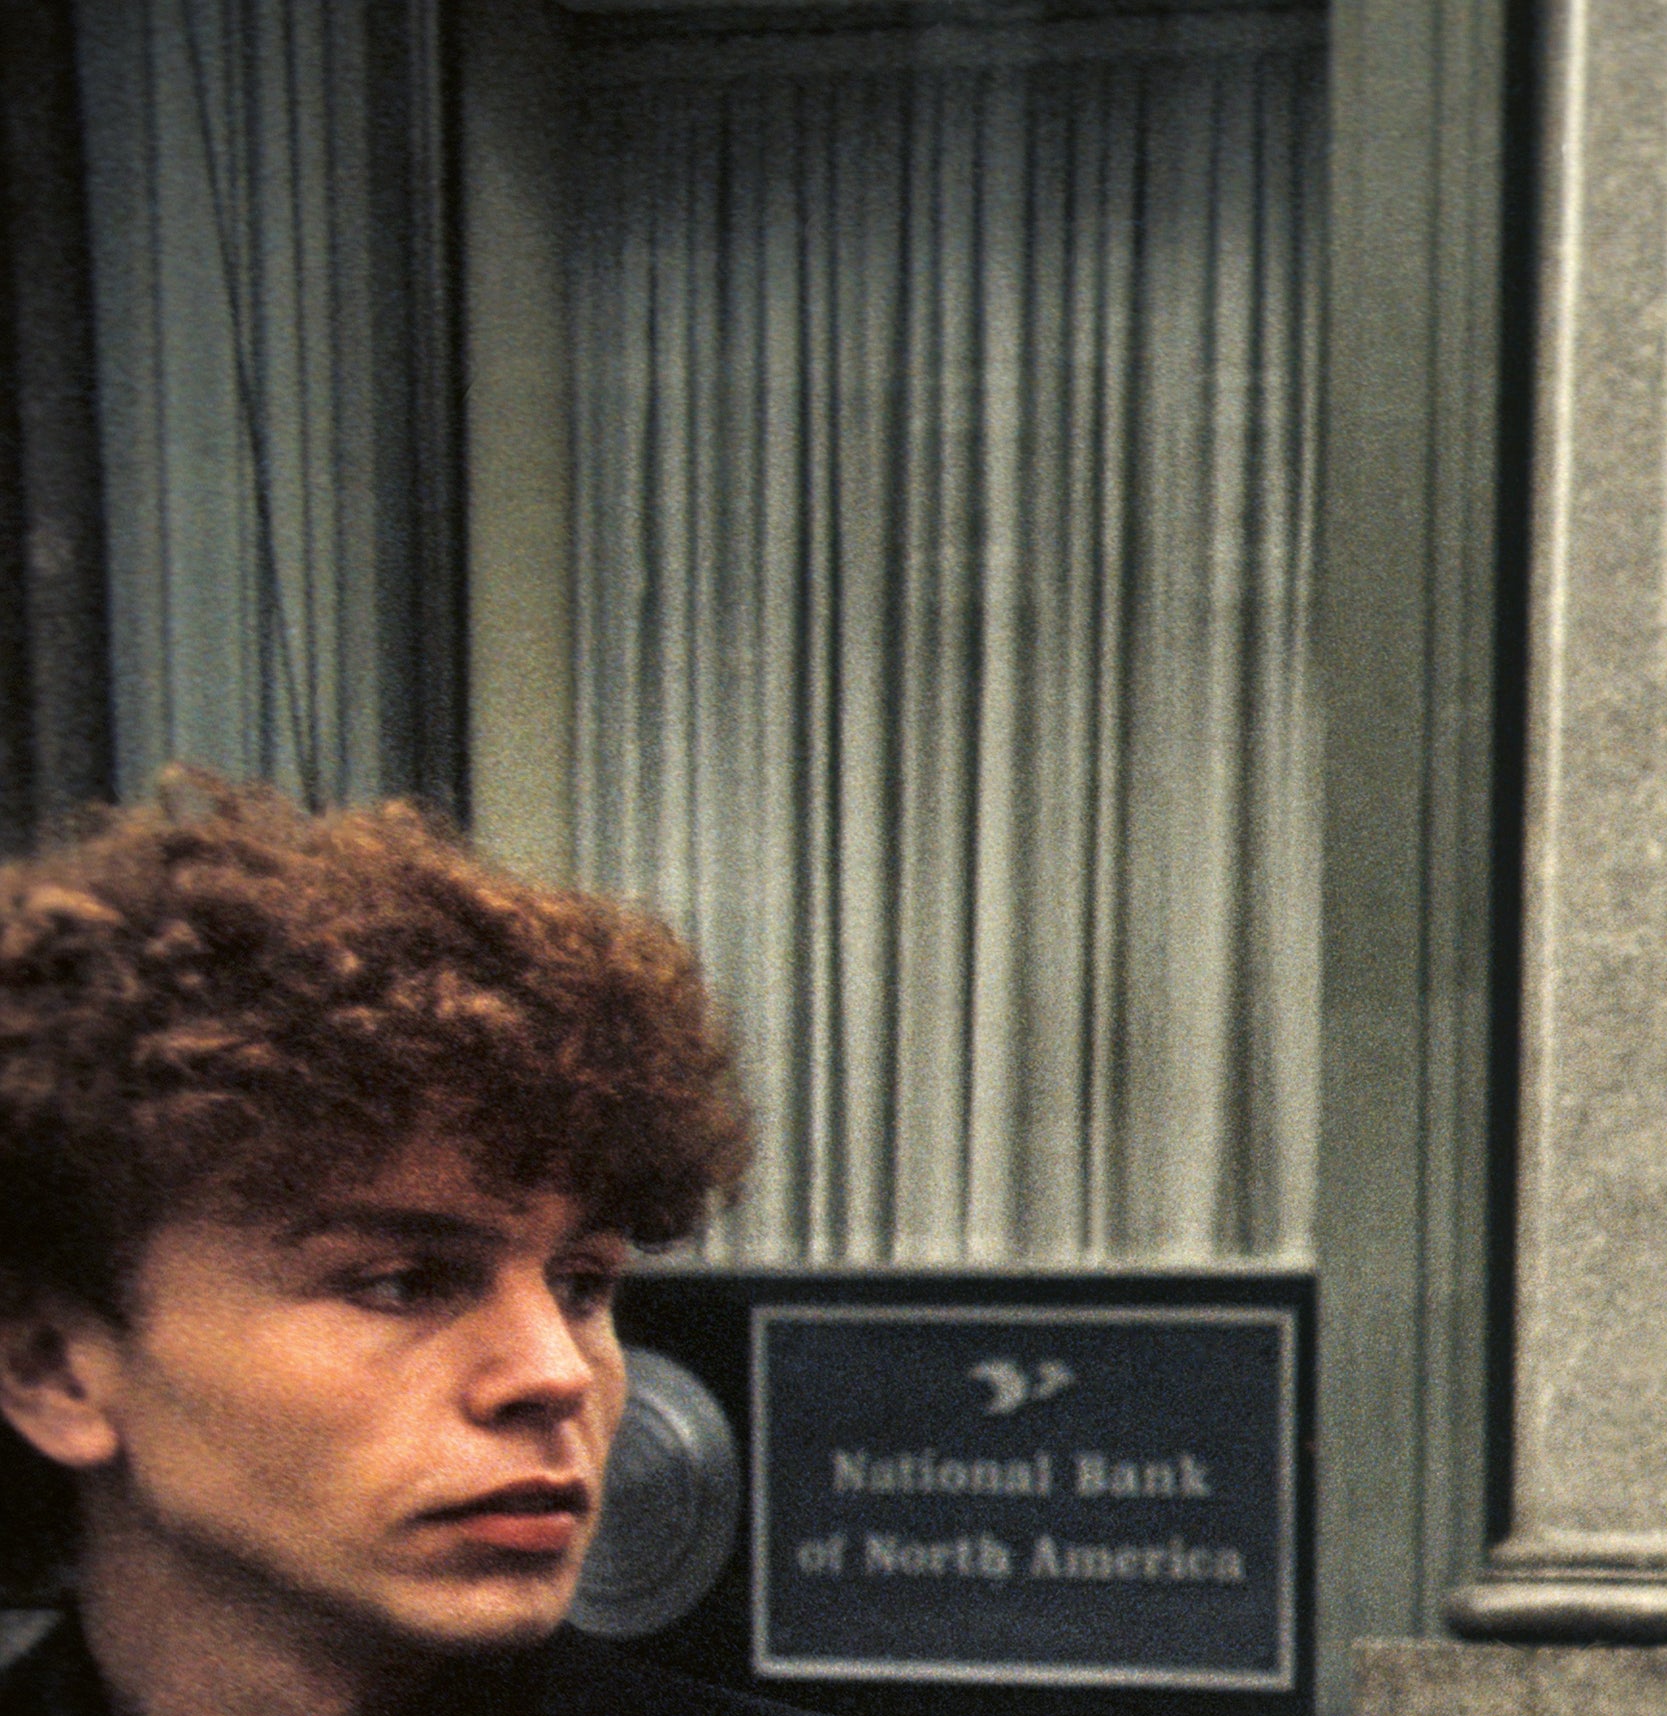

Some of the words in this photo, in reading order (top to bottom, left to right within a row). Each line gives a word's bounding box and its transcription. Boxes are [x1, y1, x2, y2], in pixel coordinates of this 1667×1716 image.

[832, 1447, 1052, 1496] National
[1076, 1449, 1211, 1498] Bank
[796, 1531, 845, 1576] of
[864, 1532, 1012, 1579] North
[1031, 1533, 1246, 1581] America
